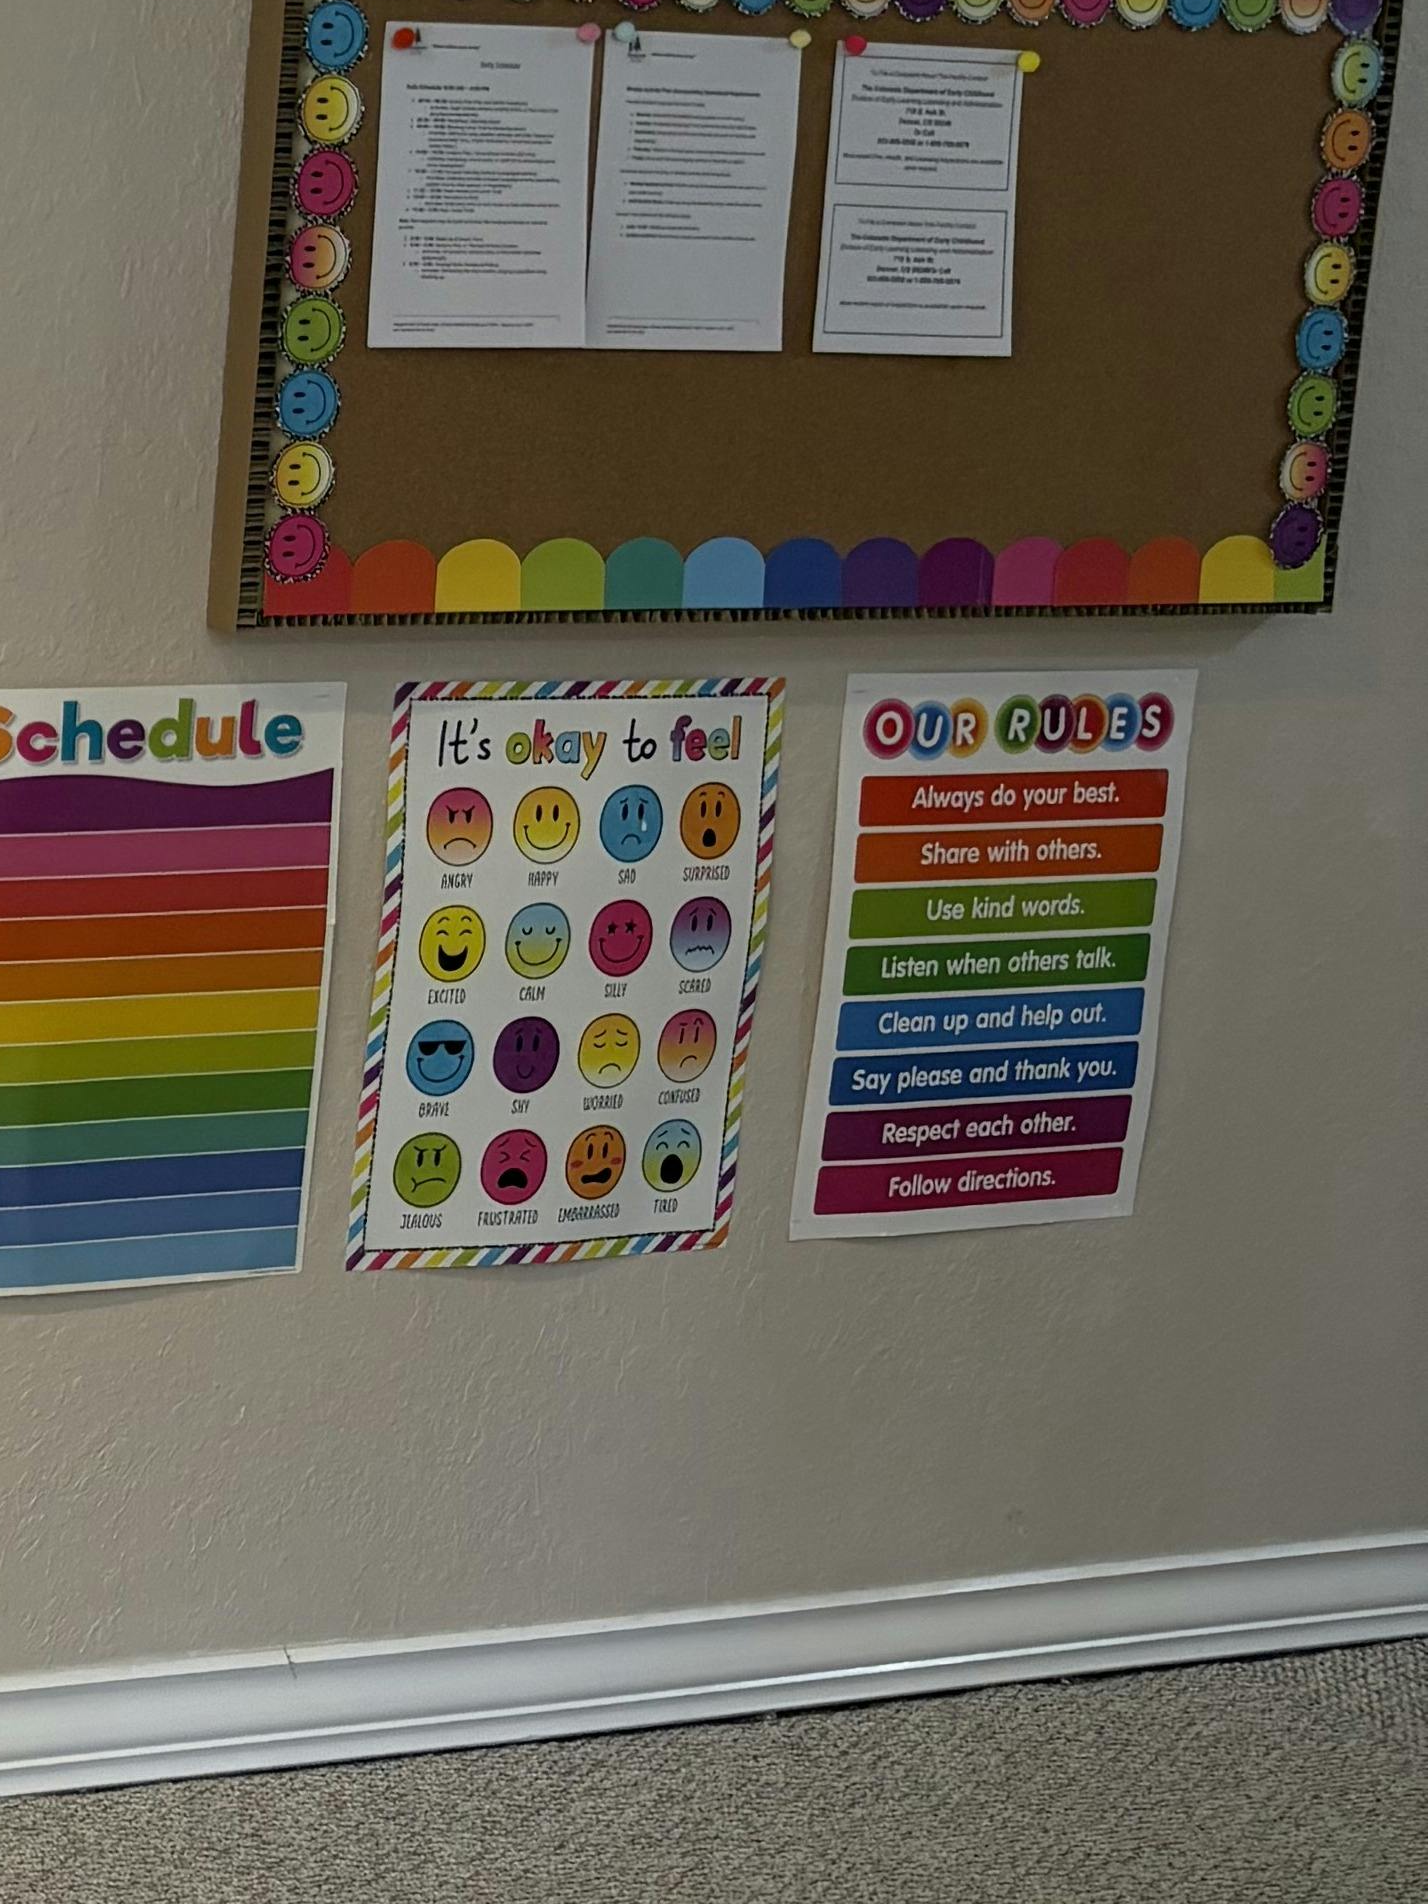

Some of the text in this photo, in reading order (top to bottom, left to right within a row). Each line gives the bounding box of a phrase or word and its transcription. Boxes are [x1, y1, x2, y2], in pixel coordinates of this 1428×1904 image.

[874, 702, 1163, 750] OUR RULES
[438, 715, 742, 781] It's okay to feel
[912, 780, 1120, 813] Always do your best.
[920, 837, 1102, 866] Share with others.
[440, 872, 474, 890] ANGRY
[527, 870, 560, 888] HAPPY
[617, 868, 637, 885] SAD
[682, 865, 731, 883] SURPRISED
[926, 894, 1085, 922] Use kind words.
[881, 946, 1117, 980] Listen when others talk.
[518, 985, 546, 1002] CALM
[603, 981, 628, 999] SILLY
[677, 977, 712, 995] SCARED
[427, 987, 467, 1005] EXCITED
[878, 1002, 1107, 1036] Clean up and help out.
[851, 1056, 1117, 1096] Say please and thank you.
[657, 1087, 701, 1106] CONFUSED
[418, 1101, 450, 1118] BRAVE
[511, 1098, 530, 1115] SHY
[881, 1112, 1076, 1147] Respect each other.
[888, 1167, 1056, 1198] Follow directions.
[557, 1205, 621, 1223] EMBARRASSED
[652, 1197, 679, 1215] TIRED
[399, 1212, 443, 1230] JEALOUS
[477, 1209, 539, 1227] FRUSTRATED
